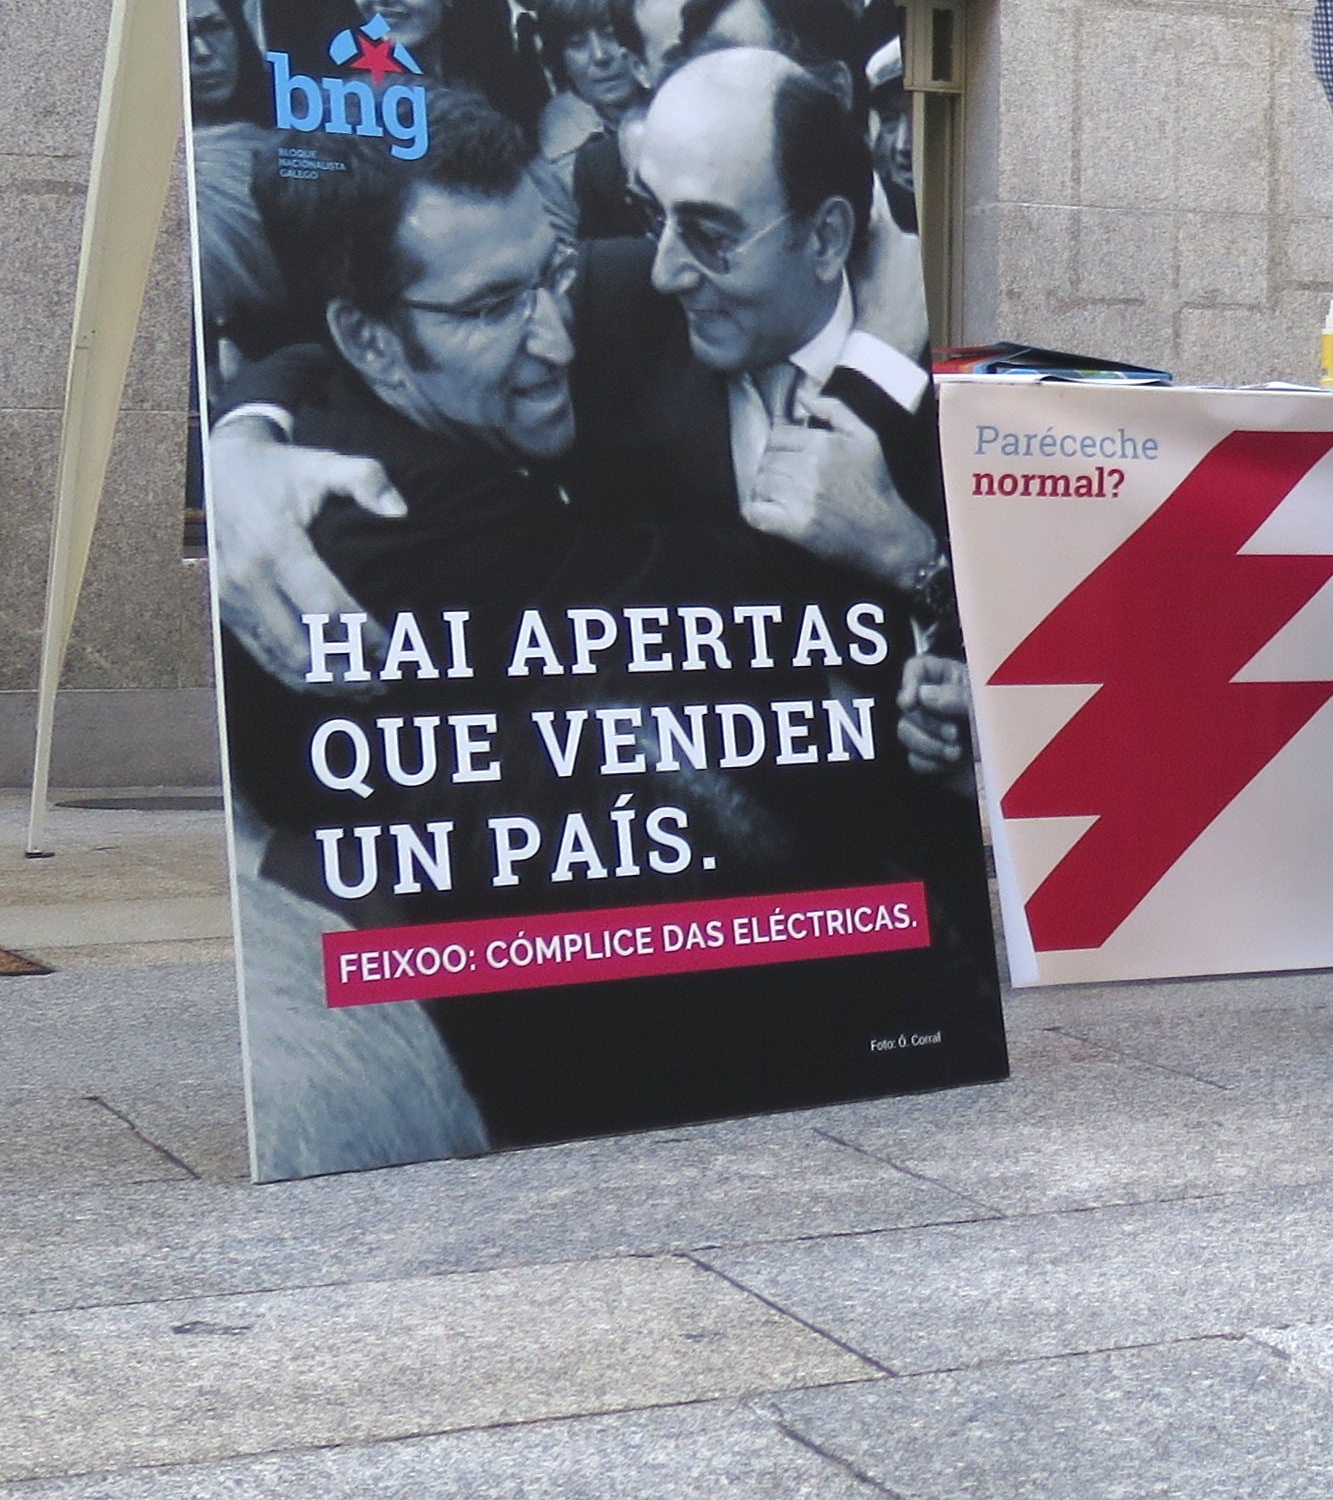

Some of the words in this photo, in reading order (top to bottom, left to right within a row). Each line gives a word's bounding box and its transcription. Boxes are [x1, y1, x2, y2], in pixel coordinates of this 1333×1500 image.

[266, 51, 429, 161] bng
[972, 466, 1125, 498] normal?
[974, 425, 1159, 460] Paréceche
[301, 610, 474, 683] HAI
[507, 603, 889, 677] APERTAS
[310, 713, 501, 799] QUE
[531, 698, 876, 777] VENDEN
[315, 820, 454, 899] UN
[488, 793, 717, 887] PAÍS.
[339, 944, 476, 984] FEIXOO:
[486, 928, 653, 970] CÓMPLICE
[662, 918, 725, 949] DAS
[733, 902, 918, 945] ELÉCTRICAS.
[870, 1040, 896, 1051] Foto:
[911, 1031, 941, 1046] Corral
